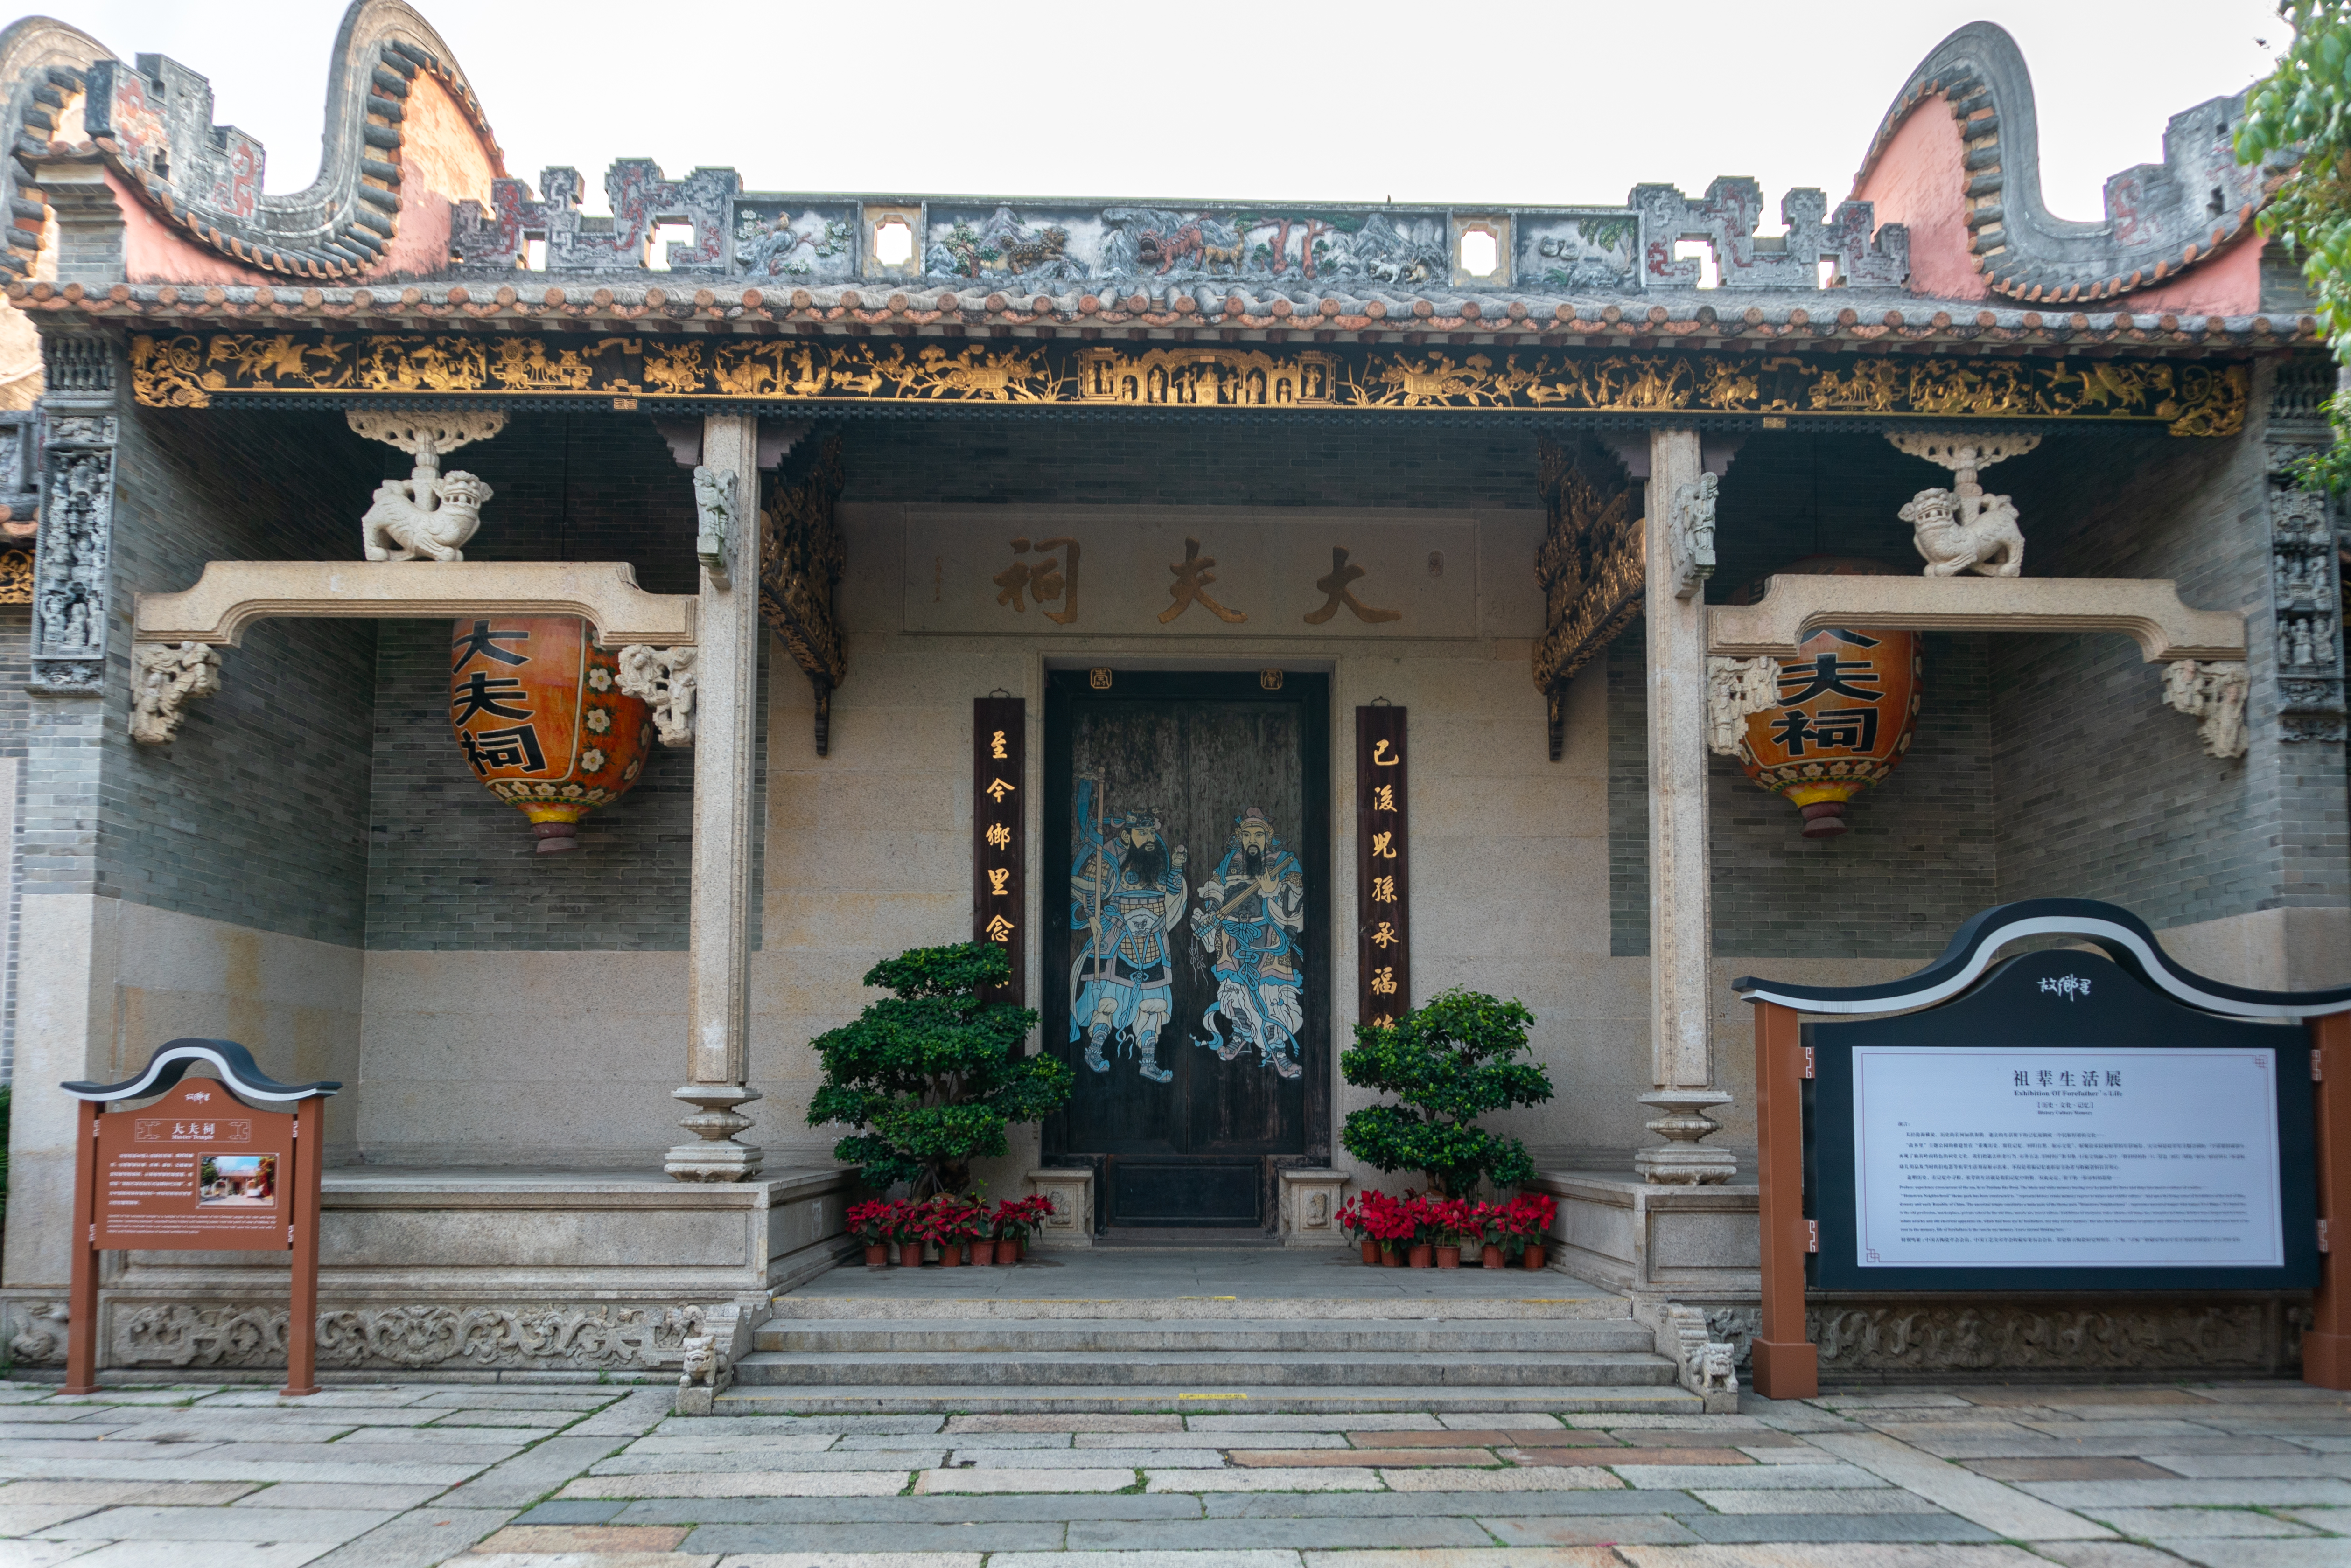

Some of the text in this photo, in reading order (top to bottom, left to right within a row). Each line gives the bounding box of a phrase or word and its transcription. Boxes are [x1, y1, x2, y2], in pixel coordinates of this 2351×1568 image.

[993, 536, 1402, 625] 大夫祠
[451, 619, 548, 777] 大夫祠
[986, 730, 1015, 988] 至今鄉里念
[171, 1122, 216, 1135] 大夫祠
